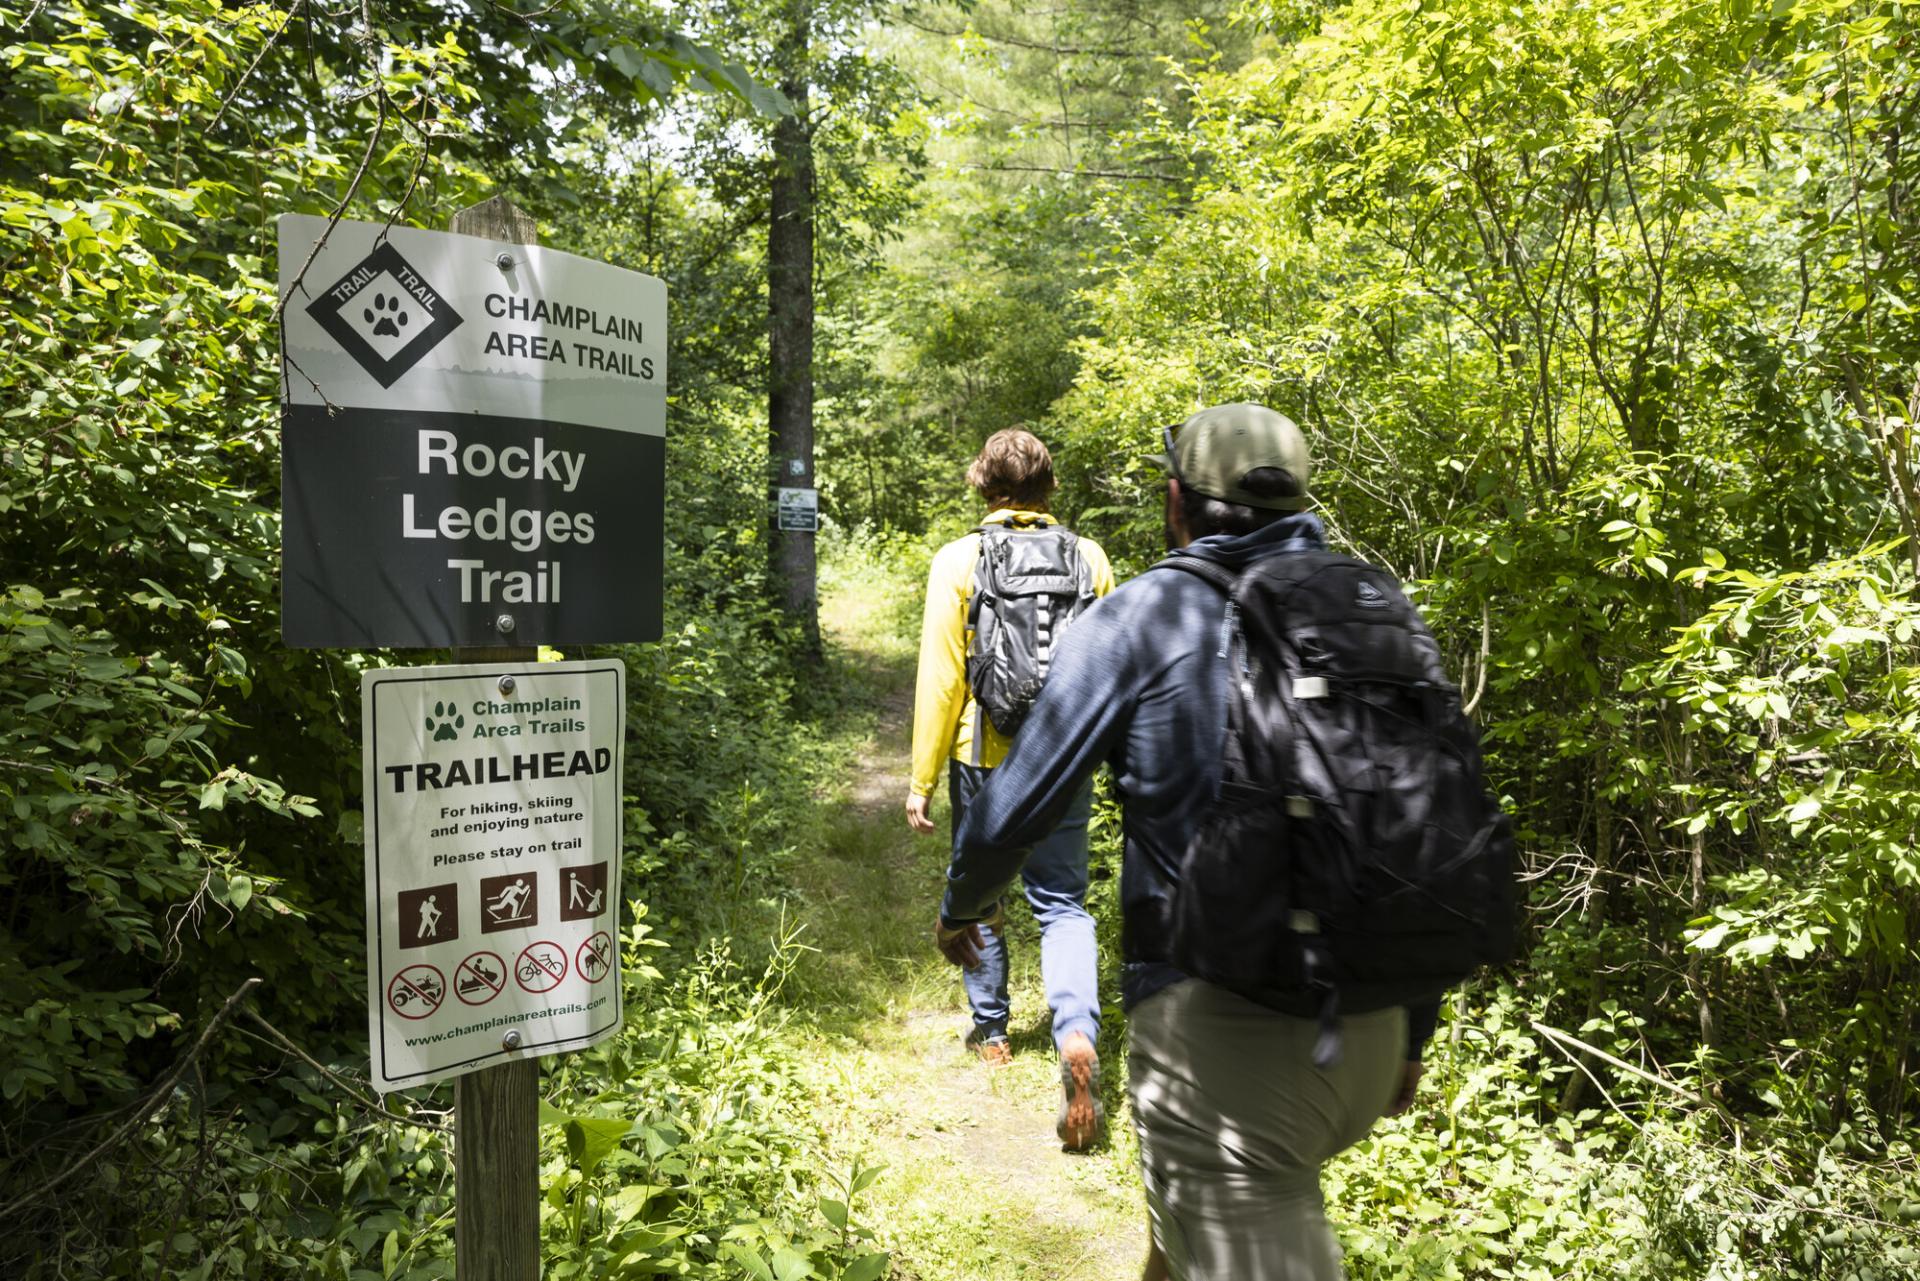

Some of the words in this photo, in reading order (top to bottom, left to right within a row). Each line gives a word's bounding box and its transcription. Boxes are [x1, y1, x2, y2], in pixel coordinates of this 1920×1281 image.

[331, 266, 378, 303] TRAIL
[397, 266, 438, 312] TRAIL
[484, 293, 643, 344] CHAMPLAIN
[484, 331, 566, 364] AREA
[573, 343, 654, 380] TRAILS
[418, 429, 586, 492] Rocky
[402, 493, 595, 552] Ledges
[447, 559, 561, 603] Trail
[473, 697, 581, 716] Champlain
[473, 723, 521, 739] Area
[528, 718, 585, 735] Trails
[385, 747, 611, 793] TRAILHEAD
[430, 823, 459, 838] and
[464, 816, 530, 834] enjoying
[534, 811, 584, 826] nature
[440, 806, 466, 819] For
[470, 801, 523, 816] hiking,
[527, 796, 573, 811] skiing
[433, 852, 485, 867] Please
[490, 846, 523, 859] stay
[528, 843, 547, 854] on
[551, 838, 582, 851] trail
[405, 996, 607, 1048] www.champlainareatrails.com
